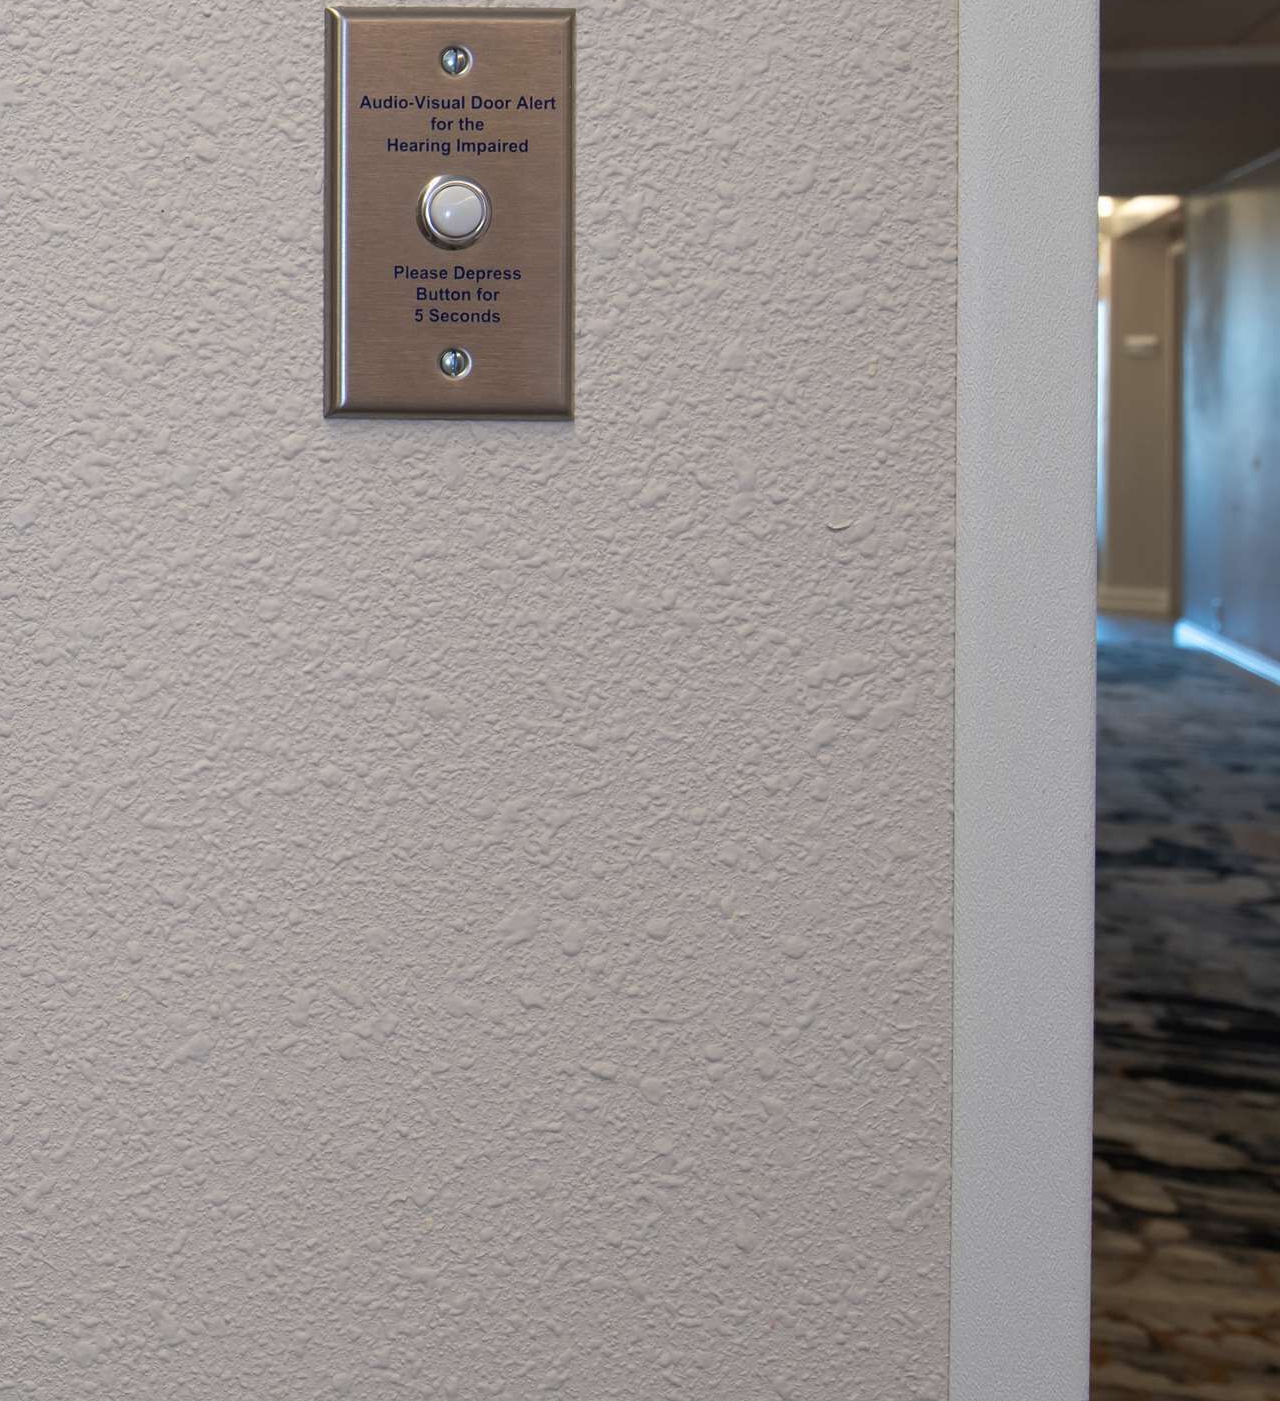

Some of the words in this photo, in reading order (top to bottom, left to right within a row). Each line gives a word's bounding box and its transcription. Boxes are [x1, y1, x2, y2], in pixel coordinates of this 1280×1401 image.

[359, 95, 466, 110] Audio-Visual
[471, 95, 512, 110] Door
[516, 95, 557, 110] Alert
[430, 116, 454, 131] for
[458, 116, 485, 131] the
[387, 138, 451, 156] Hearing
[456, 138, 529, 156] Impaired
[394, 265, 448, 280] Please
[453, 265, 522, 284] Depress
[416, 286, 471, 301] Button
[476, 286, 501, 302] for
[414, 308, 424, 323] 5
[429, 308, 501, 323] Seconds
